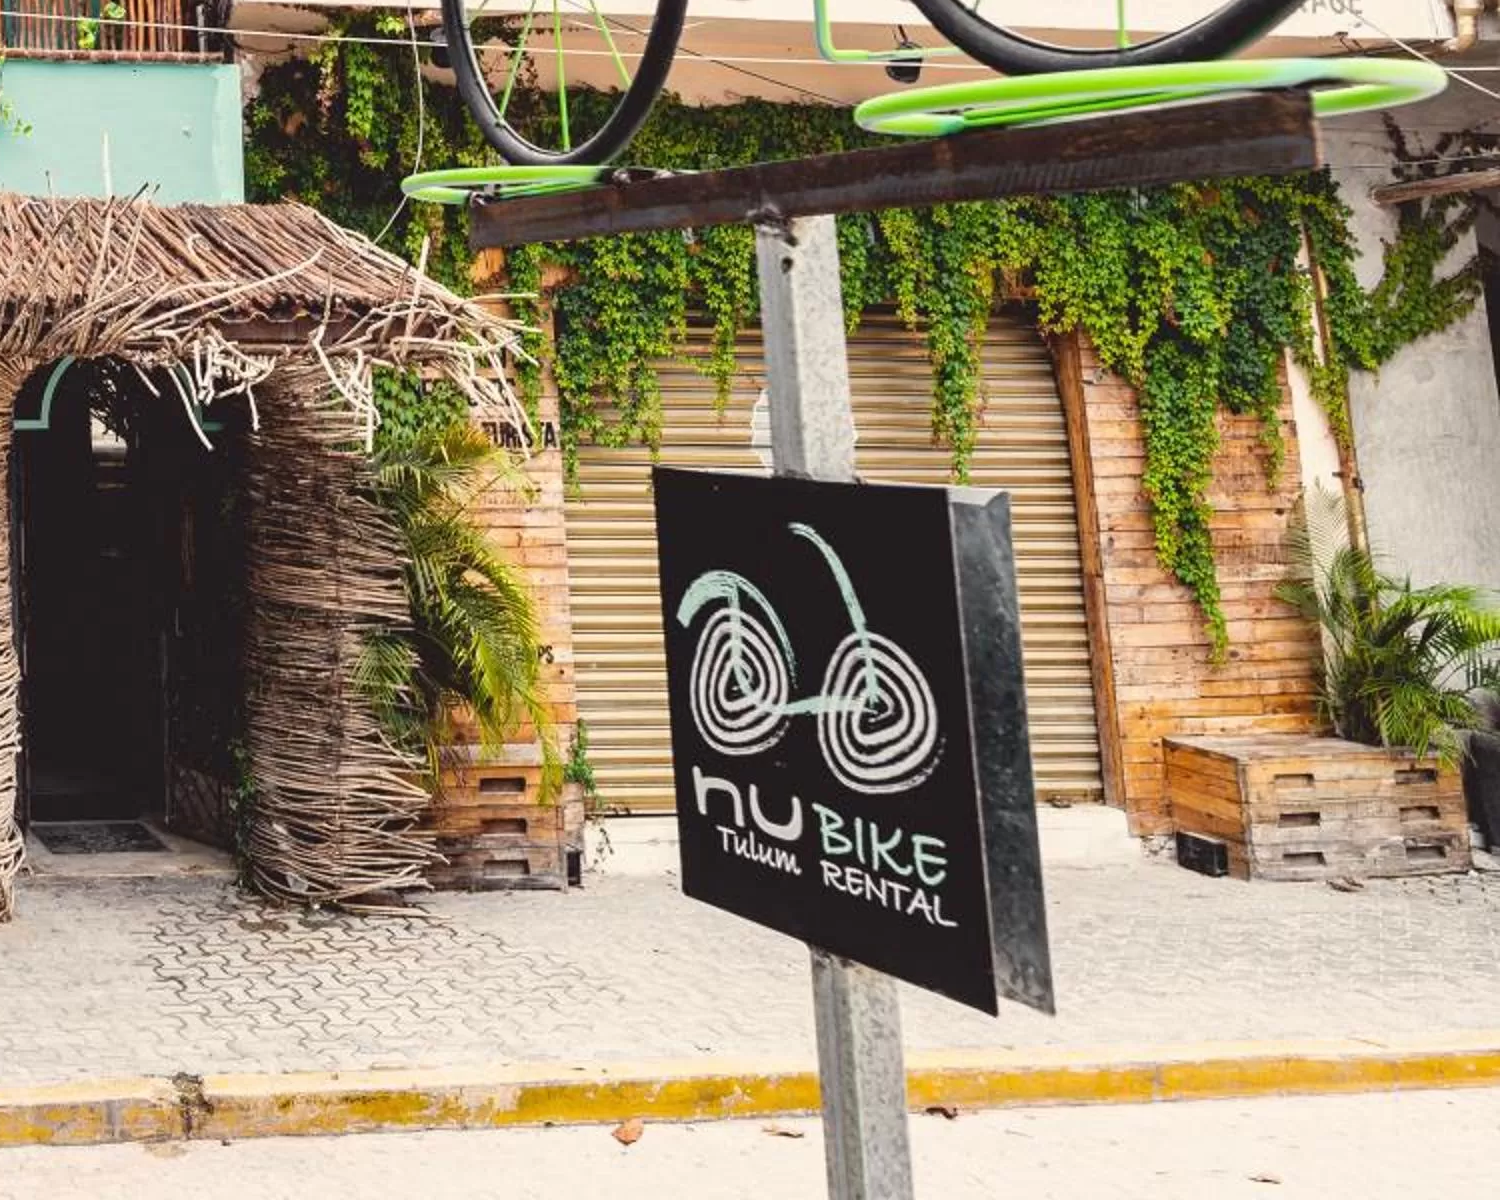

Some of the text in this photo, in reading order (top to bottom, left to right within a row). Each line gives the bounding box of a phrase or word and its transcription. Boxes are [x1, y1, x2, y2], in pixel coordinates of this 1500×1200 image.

[690, 763, 949, 886] nu BIKE
[717, 825, 960, 929] Tulum RENTAL
